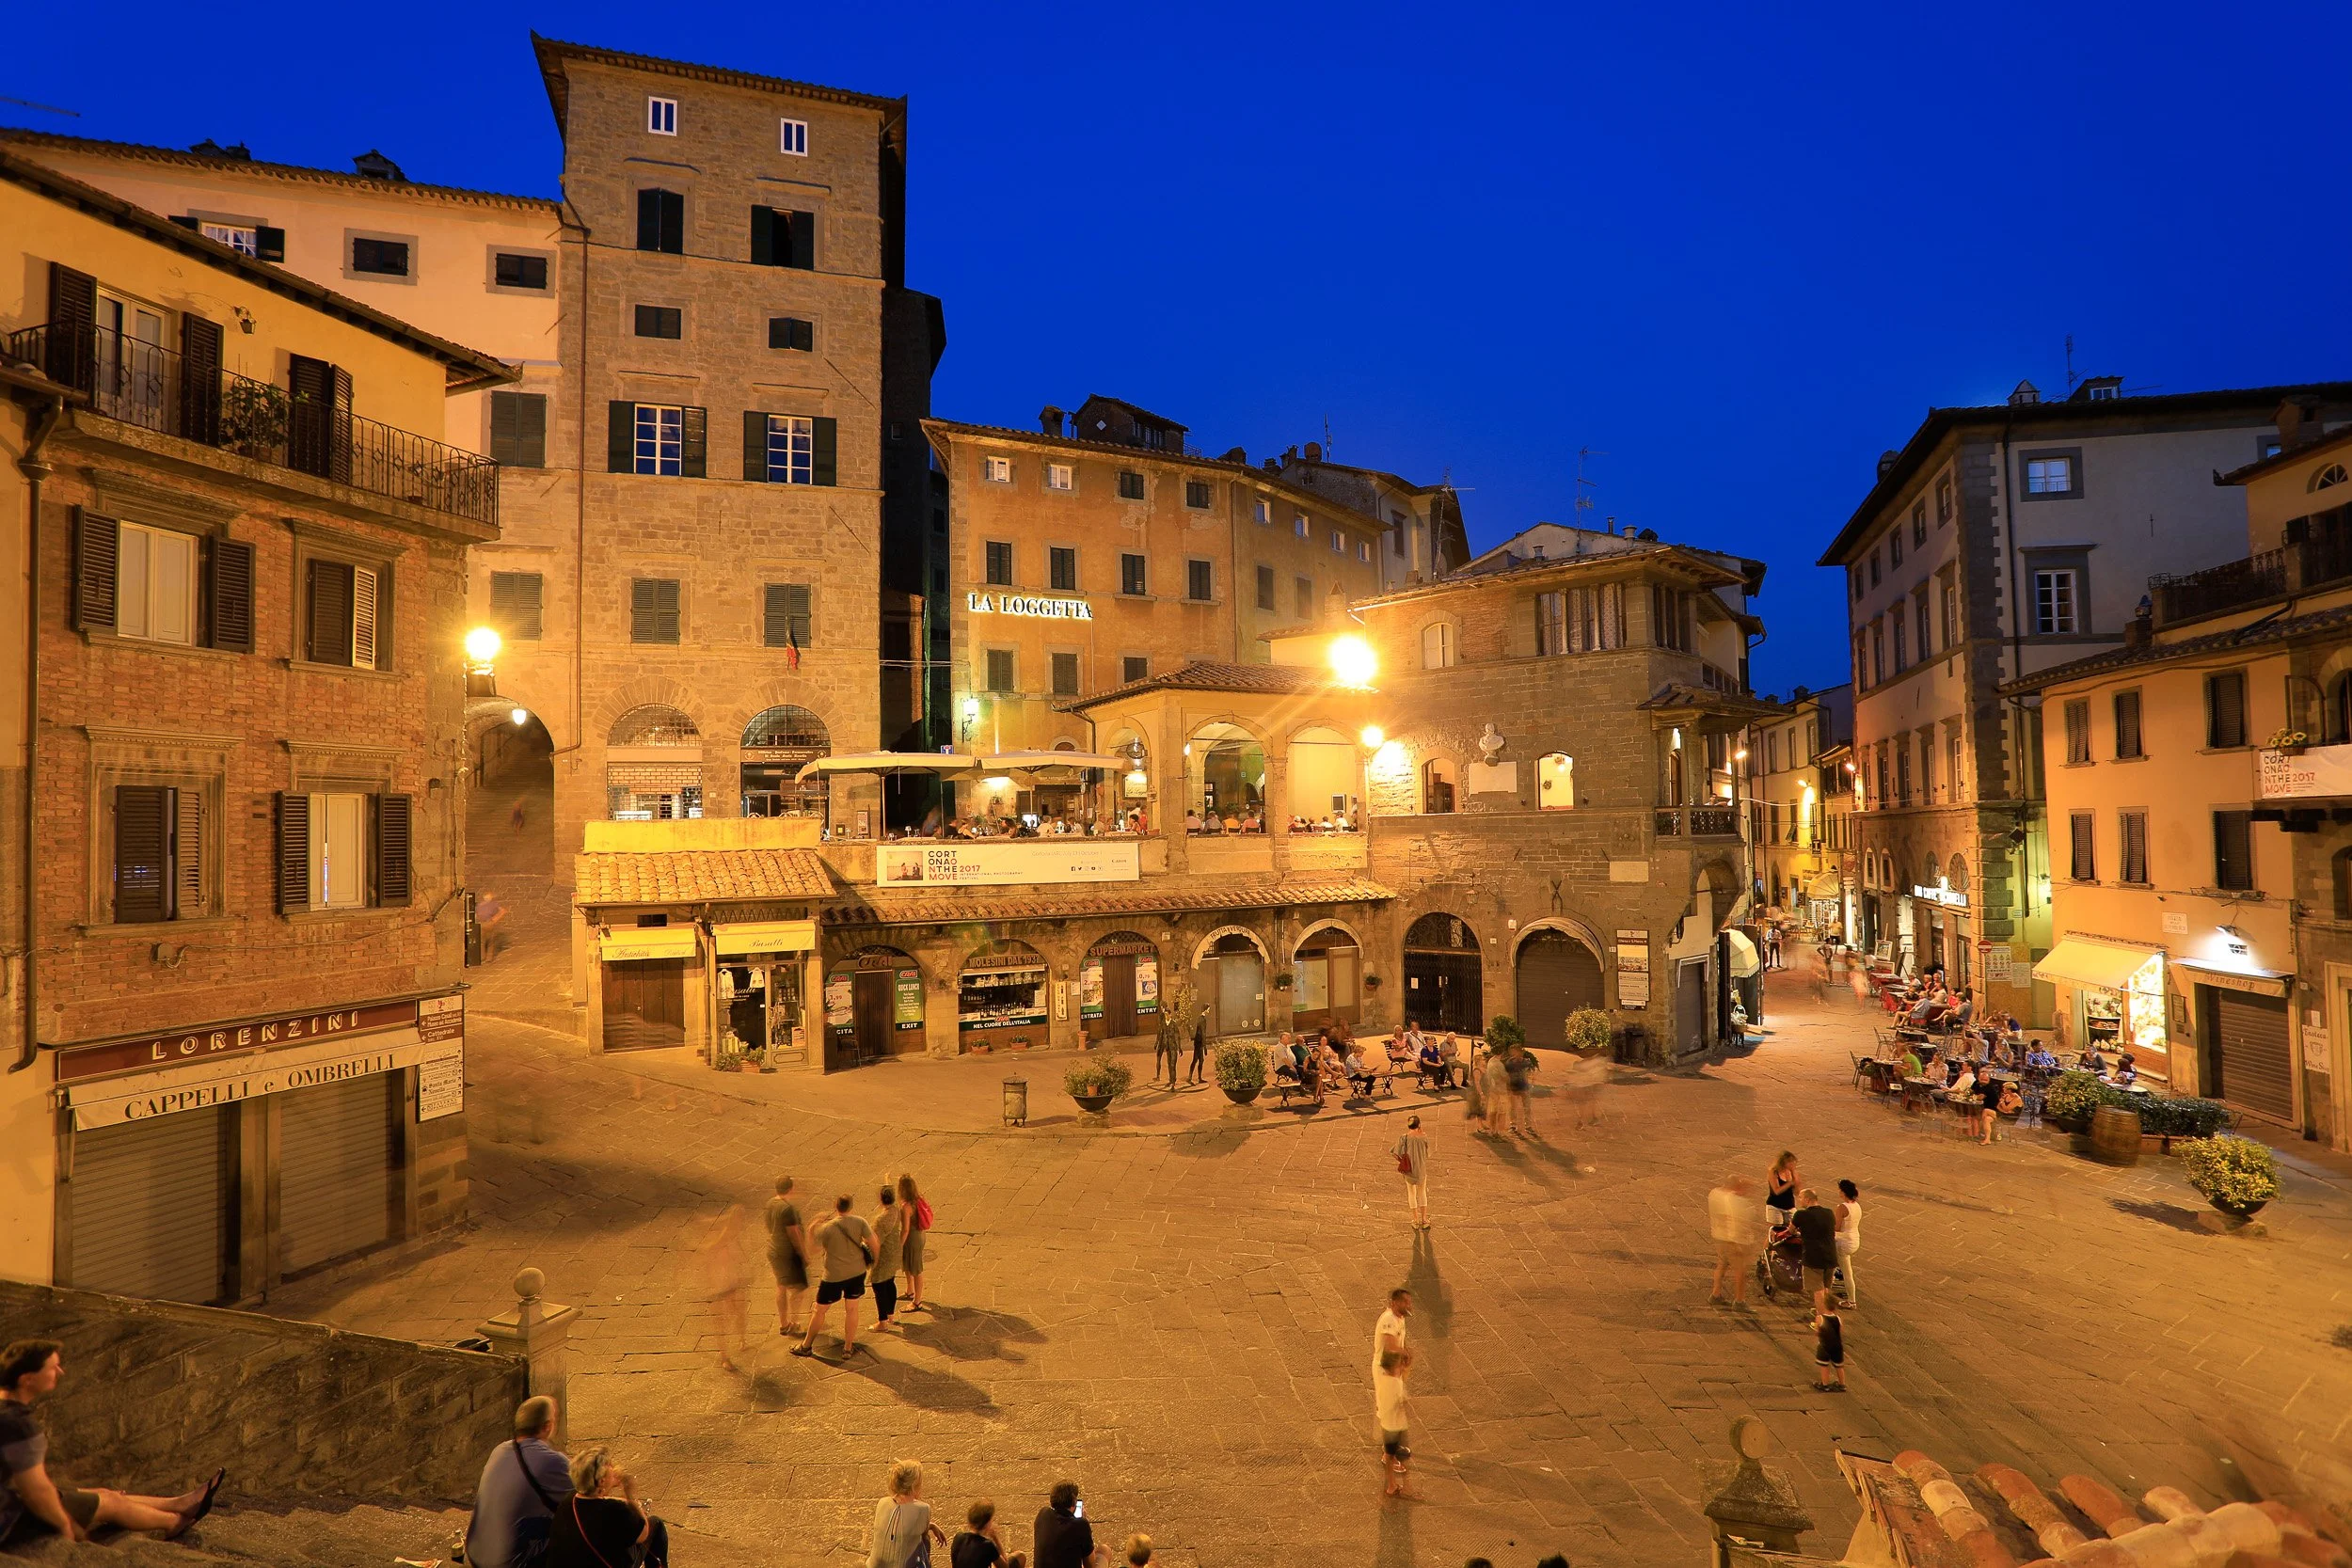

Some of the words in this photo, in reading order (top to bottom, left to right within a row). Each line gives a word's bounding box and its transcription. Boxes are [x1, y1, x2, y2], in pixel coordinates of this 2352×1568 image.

[970, 594, 994, 611] LA
[1002, 596, 1094, 619] LOGGETTA
[2264, 755, 2291, 765] CORT
[2264, 765, 2290, 775] ONAO
[2265, 774, 2291, 784] NTHE
[2292, 772, 2315, 783] 2017
[2265, 784, 2292, 794] MOVE
[959, 864, 980, 873] 2017
[1210, 927, 1228, 939] FRUTTA
[1089, 944, 1155, 957] SUPERMARKET
[969, 957, 1006, 968] MOLESINI
[1008, 955, 1023, 965] DAL
[2206, 972, 2255, 990] Wineshop
[898, 984, 909, 992] QUICK
[151, 1010, 358, 1061] LORENZINI
[427, 1028, 455, 1037] Cattedrale
[124, 1079, 250, 1120] CAPPELLI
[263, 1080, 275, 1093] e
[287, 1053, 394, 1088] OMBRELLI
